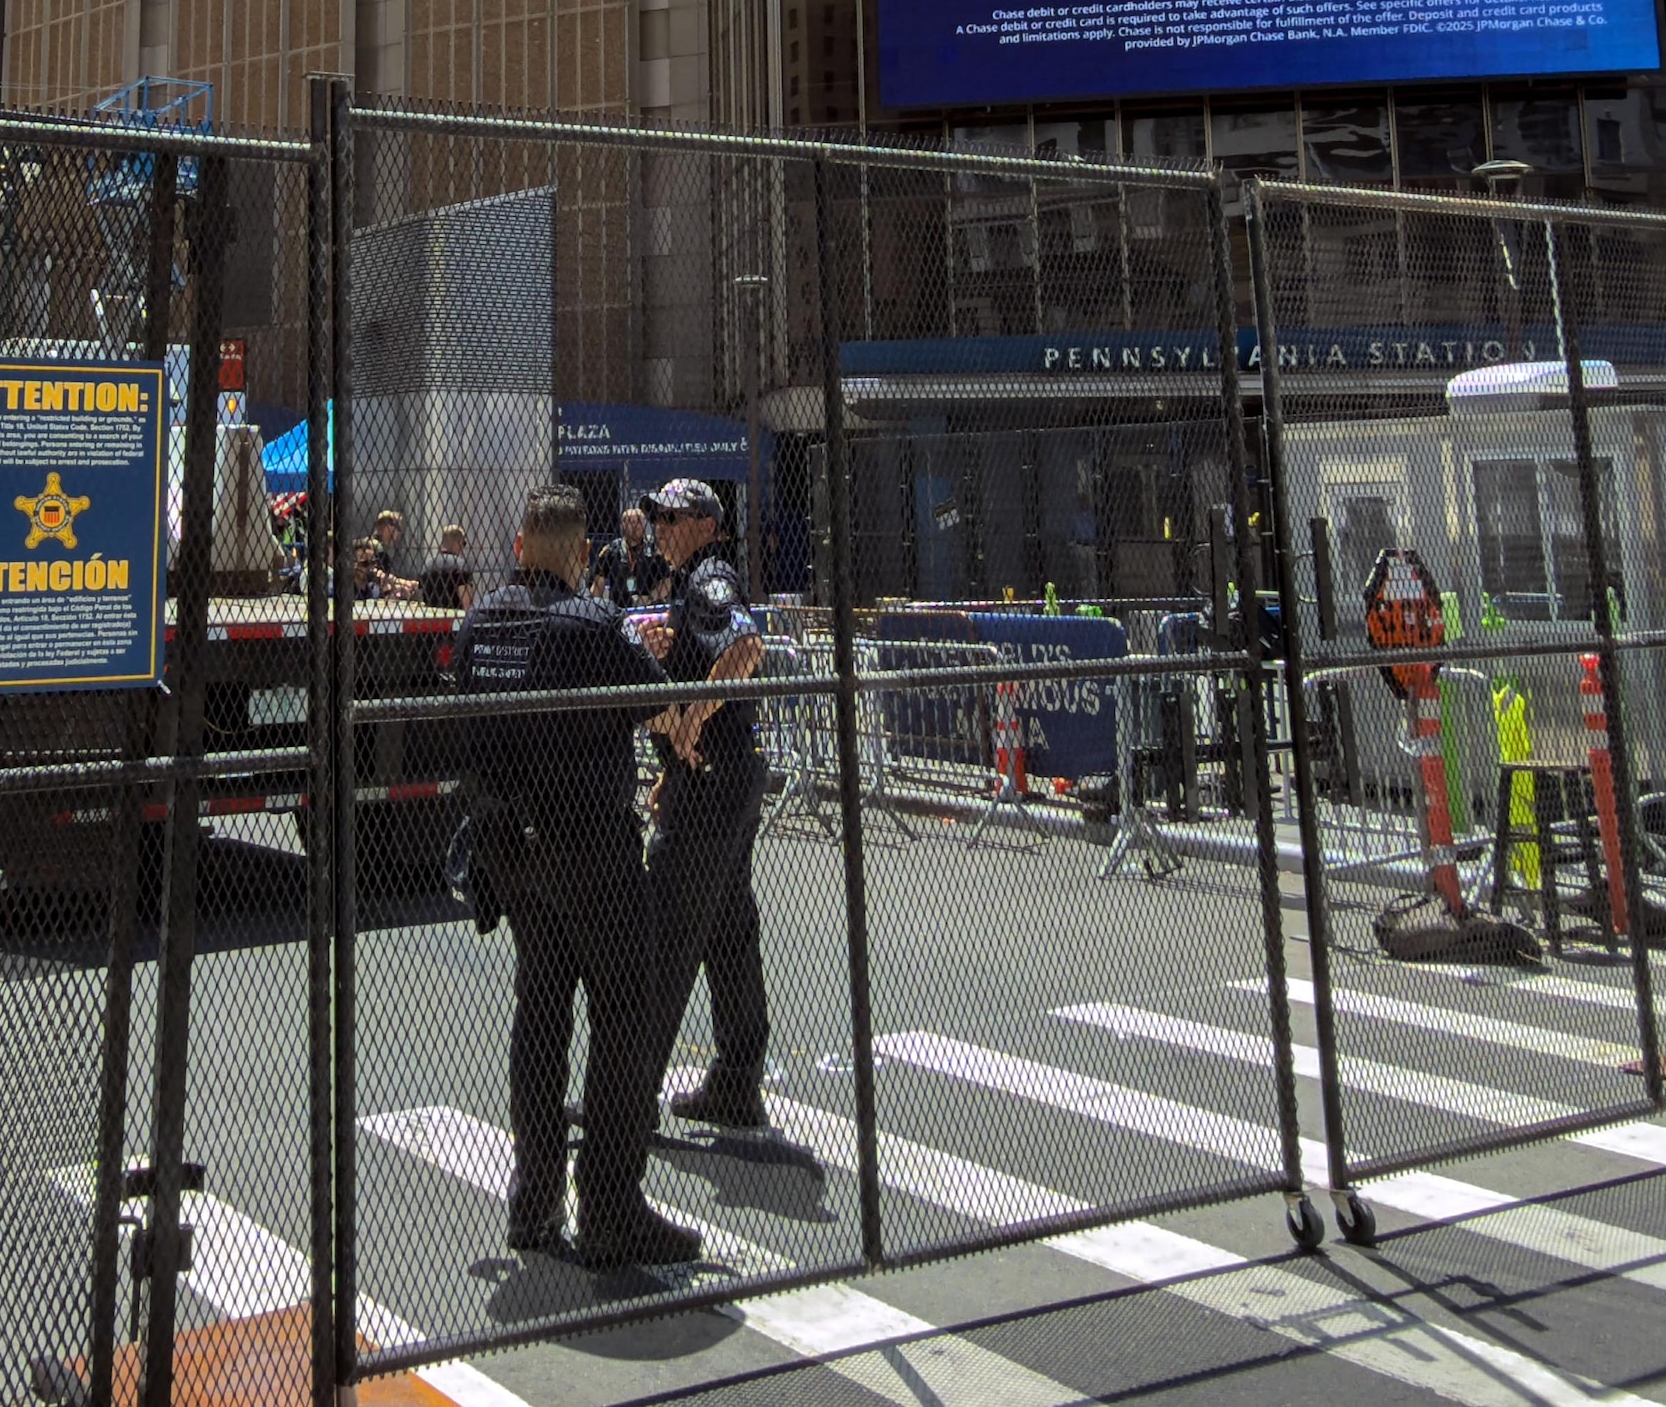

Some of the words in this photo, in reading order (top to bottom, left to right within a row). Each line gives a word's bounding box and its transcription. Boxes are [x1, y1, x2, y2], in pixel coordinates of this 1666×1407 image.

[955, 25, 963, 33] A
[965, 24, 998, 33] Chase
[1000, 20, 1028, 33] debit
[1030, 21, 1043, 29] or
[1045, 18, 1076, 28] credit
[1079, 16, 1103, 26] card
[1106, 15, 1115, 24] is
[1117, 12, 1165, 25] required
[1168, 13, 1180, 21] to
[1182, 9, 1207, 20] take
[1209, 7, 1269, 18] advantage
[1271, 4, 1283, 14] of
[1286, 3, 1313, 14] such
[1315, 2, 1353, 12] offers.
[1356, 0, 1376, 10] See
[992, 10, 1024, 19] Chase
[1026, 7, 1054, 17] debit
[1057, 7, 1069, 15] or
[1071, 4, 1103, 14] credit
[1105, 0, 1172, 12] cardholders
[1175, 0, 1199, 9] may
[999, 33, 1019, 44] and
[1022, 30, 1080, 41] limitations
[1082, 28, 1115, 40] apply.
[1118, 26, 1151, 36] Chase
[1154, 25, 1163, 34] is
[1165, 24, 1185, 33] not
[1187, 19, 1252, 33] responsible
[1255, 18, 1272, 28] for
[1275, 16, 1334, 27] fulfillment
[1337, 14, 1349, 23] of
[1352, 13, 1371, 22] the
[1375, 11, 1405, 21] offer.
[1408, 9, 1453, 21] Deposit
[1456, 7, 1478, 17] and
[1482, 6, 1515, 16] credit
[1519, 4, 1545, 14] card
[1549, 3, 1603, 15] products
[1124, 36, 1173, 51] provided
[1176, 36, 1190, 47] by
[1191, 34, 1247, 46] JPMorgan
[1249, 31, 1284, 41] Chase
[1287, 28, 1319, 39] Bank,
[1322, 27, 1348, 37] N.A.
[1350, 25, 1398, 35] Member
[1403, 22, 1432, 32] FDIC.
[1477, 20, 1533, 31] JPMorgan
[1537, 17, 1571, 26] Chase
[1575, 16, 1585, 24] &
[1588, 15, 1607, 24] Co.
[1043, 344, 1347, 369] PENNSYLANIA
[1368, 340, 1535, 364] STATION
